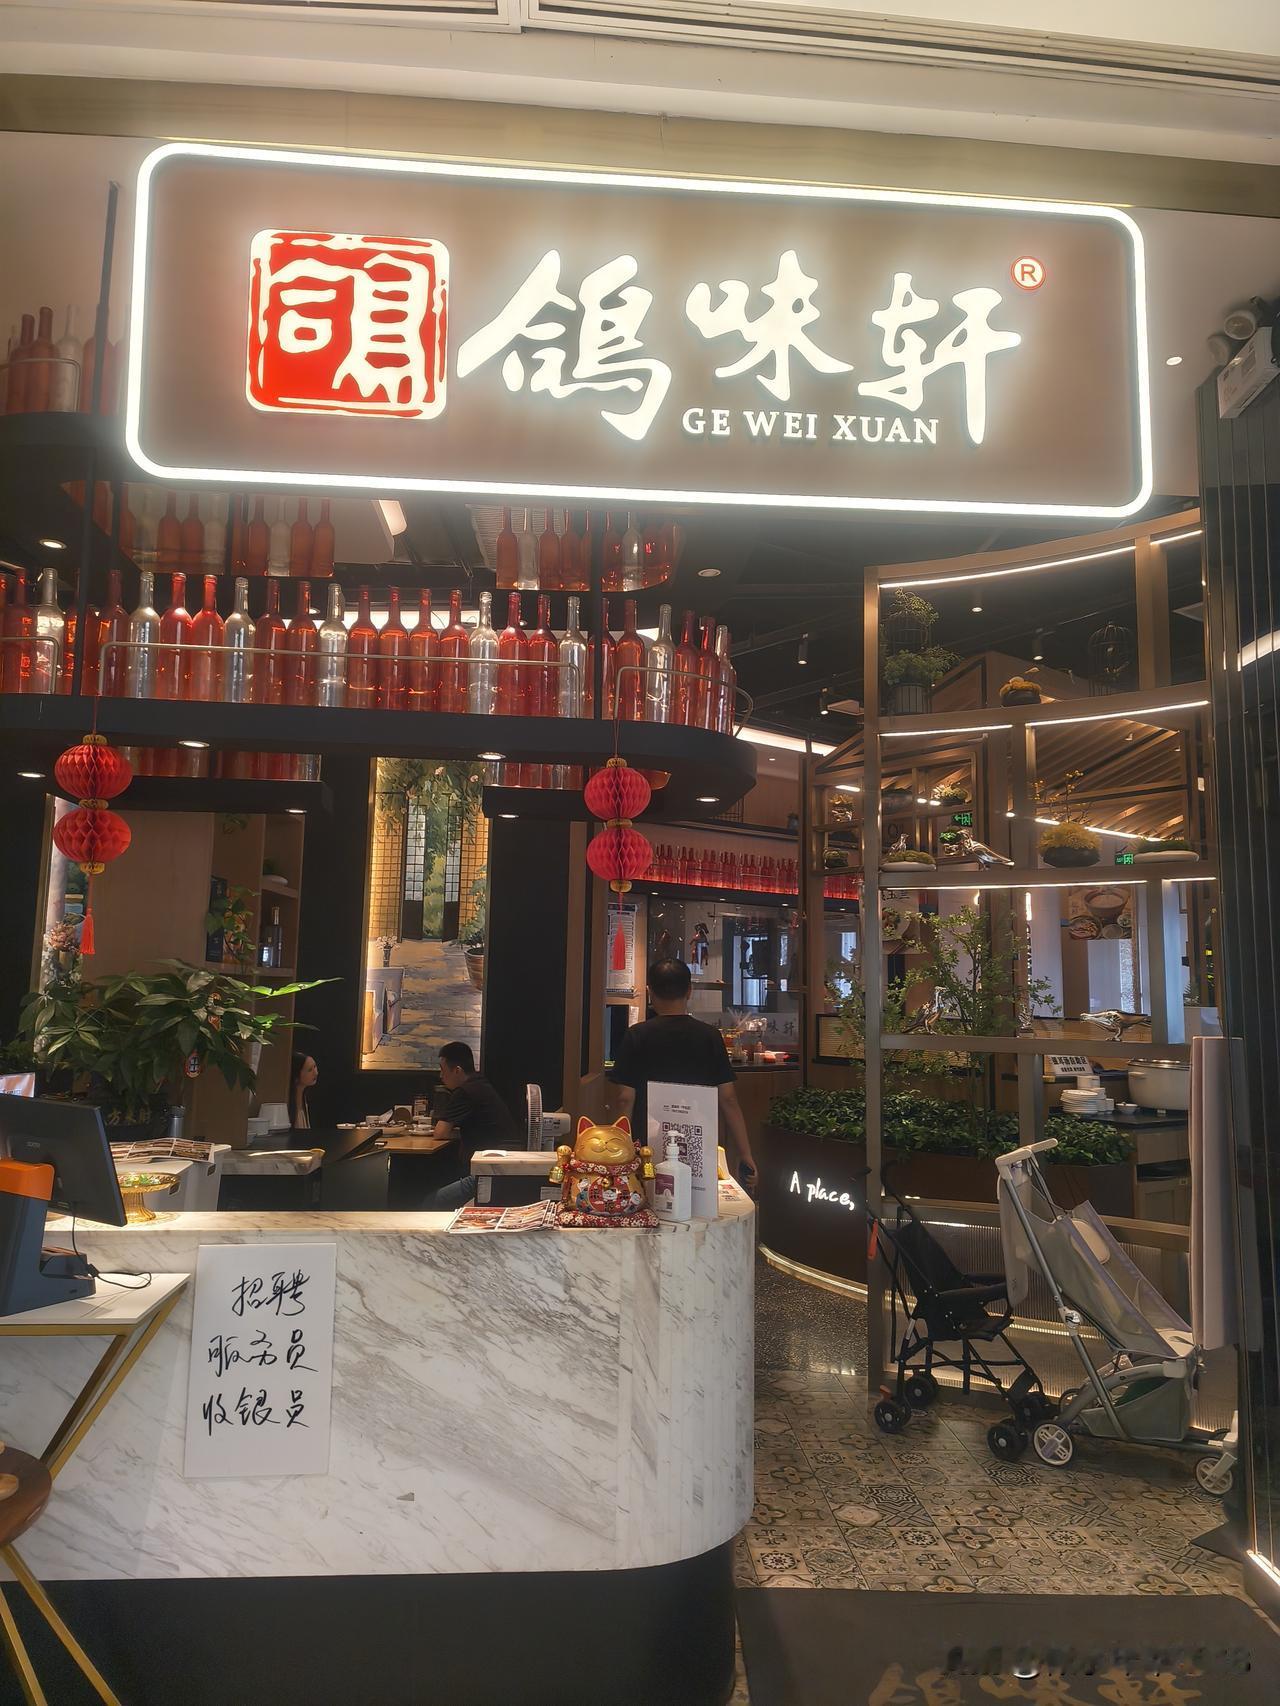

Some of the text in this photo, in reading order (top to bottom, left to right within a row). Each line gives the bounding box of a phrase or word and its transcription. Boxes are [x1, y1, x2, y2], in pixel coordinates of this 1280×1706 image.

[457, 249, 1022, 445] 鸽味轩
[682, 407, 940, 445] GE WEI XUAN
[789, 1170, 801, 1194] A
[232, 1269, 310, 1317] 招聘
[207, 1328, 319, 1378] 服务员
[202, 1386, 310, 1437] 收银员
